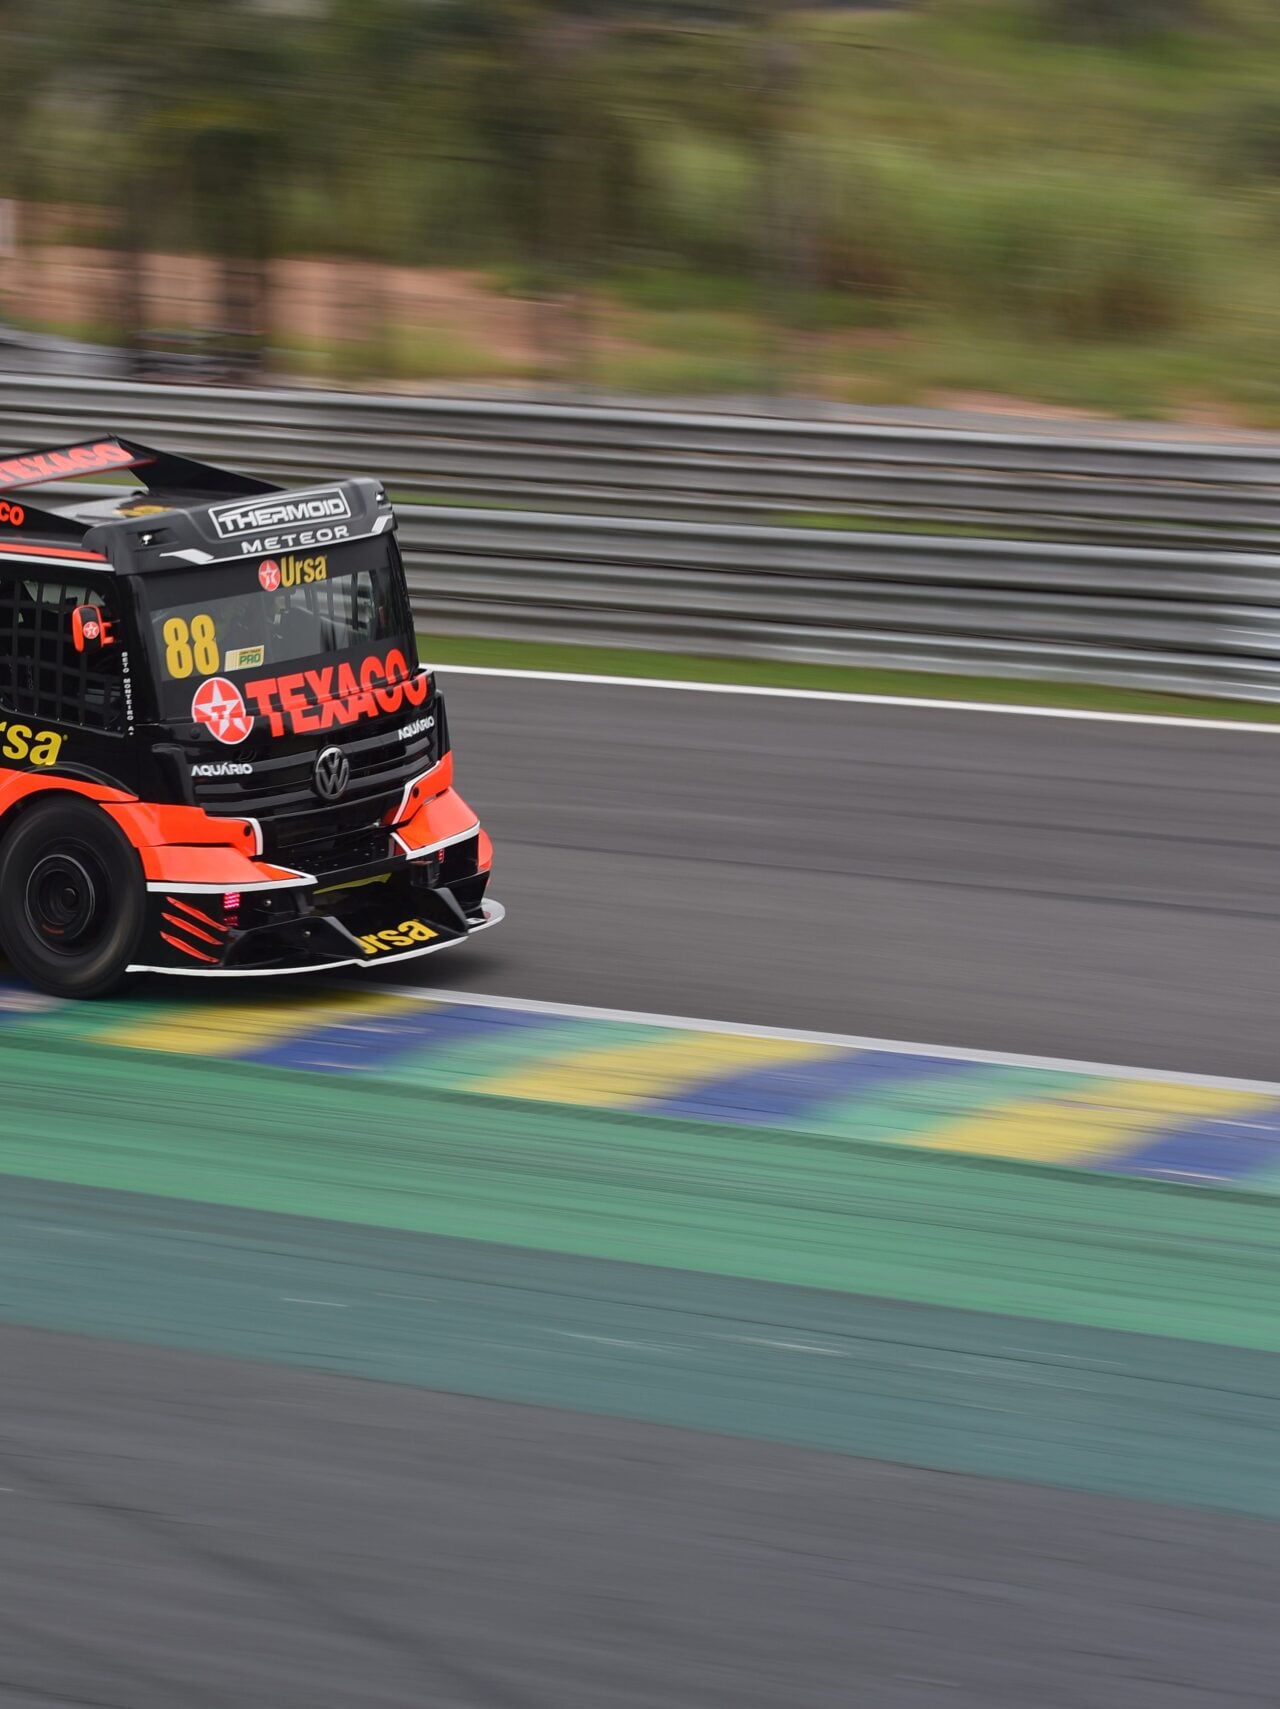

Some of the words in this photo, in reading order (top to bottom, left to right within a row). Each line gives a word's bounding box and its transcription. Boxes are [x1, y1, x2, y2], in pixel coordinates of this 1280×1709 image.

[218, 498, 345, 531] THERMOID
[241, 525, 349, 554] METEOR
[281, 555, 327, 587] Ursa
[163, 614, 219, 679] 88
[245, 649, 428, 737] TEXACO
[398, 716, 434, 740] AQUÁRIO
[191, 762, 253, 777] AQUÁRIO
